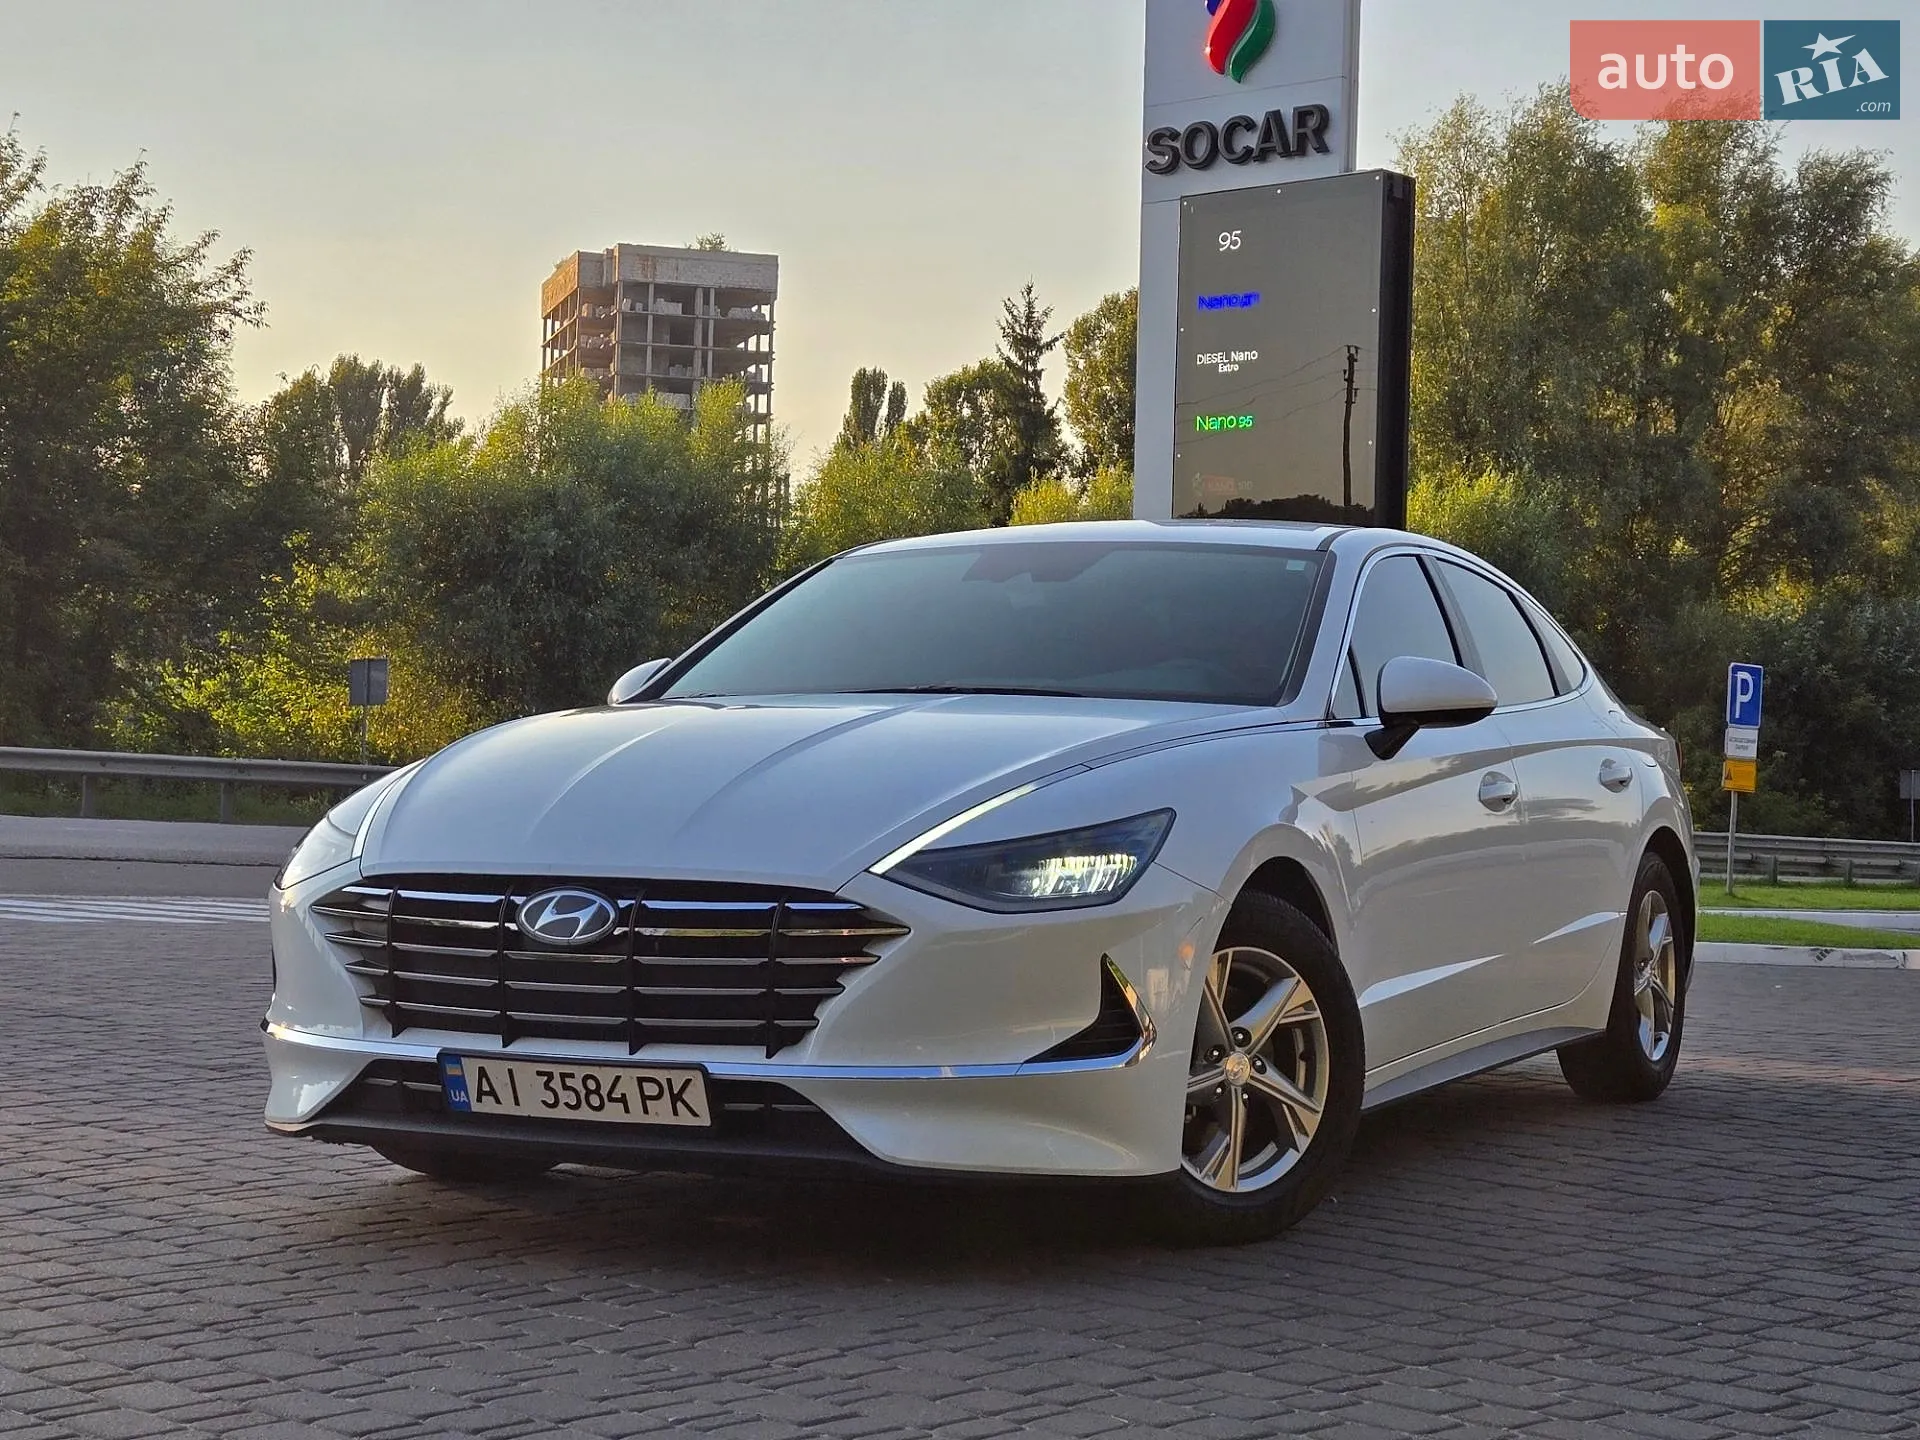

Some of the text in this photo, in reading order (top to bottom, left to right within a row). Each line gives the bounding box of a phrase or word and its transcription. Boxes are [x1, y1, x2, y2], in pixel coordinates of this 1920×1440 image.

[1144, 103, 1330, 175] SOCAR
[1218, 230, 1242, 251] 95
[1196, 350, 1258, 365] DIESEL Nano
[1196, 415, 1253, 431] Nano 95
[1735, 671, 1754, 719] P
[451, 1089, 468, 1103] UA
[475, 1065, 700, 1118] AI 3584 PK
